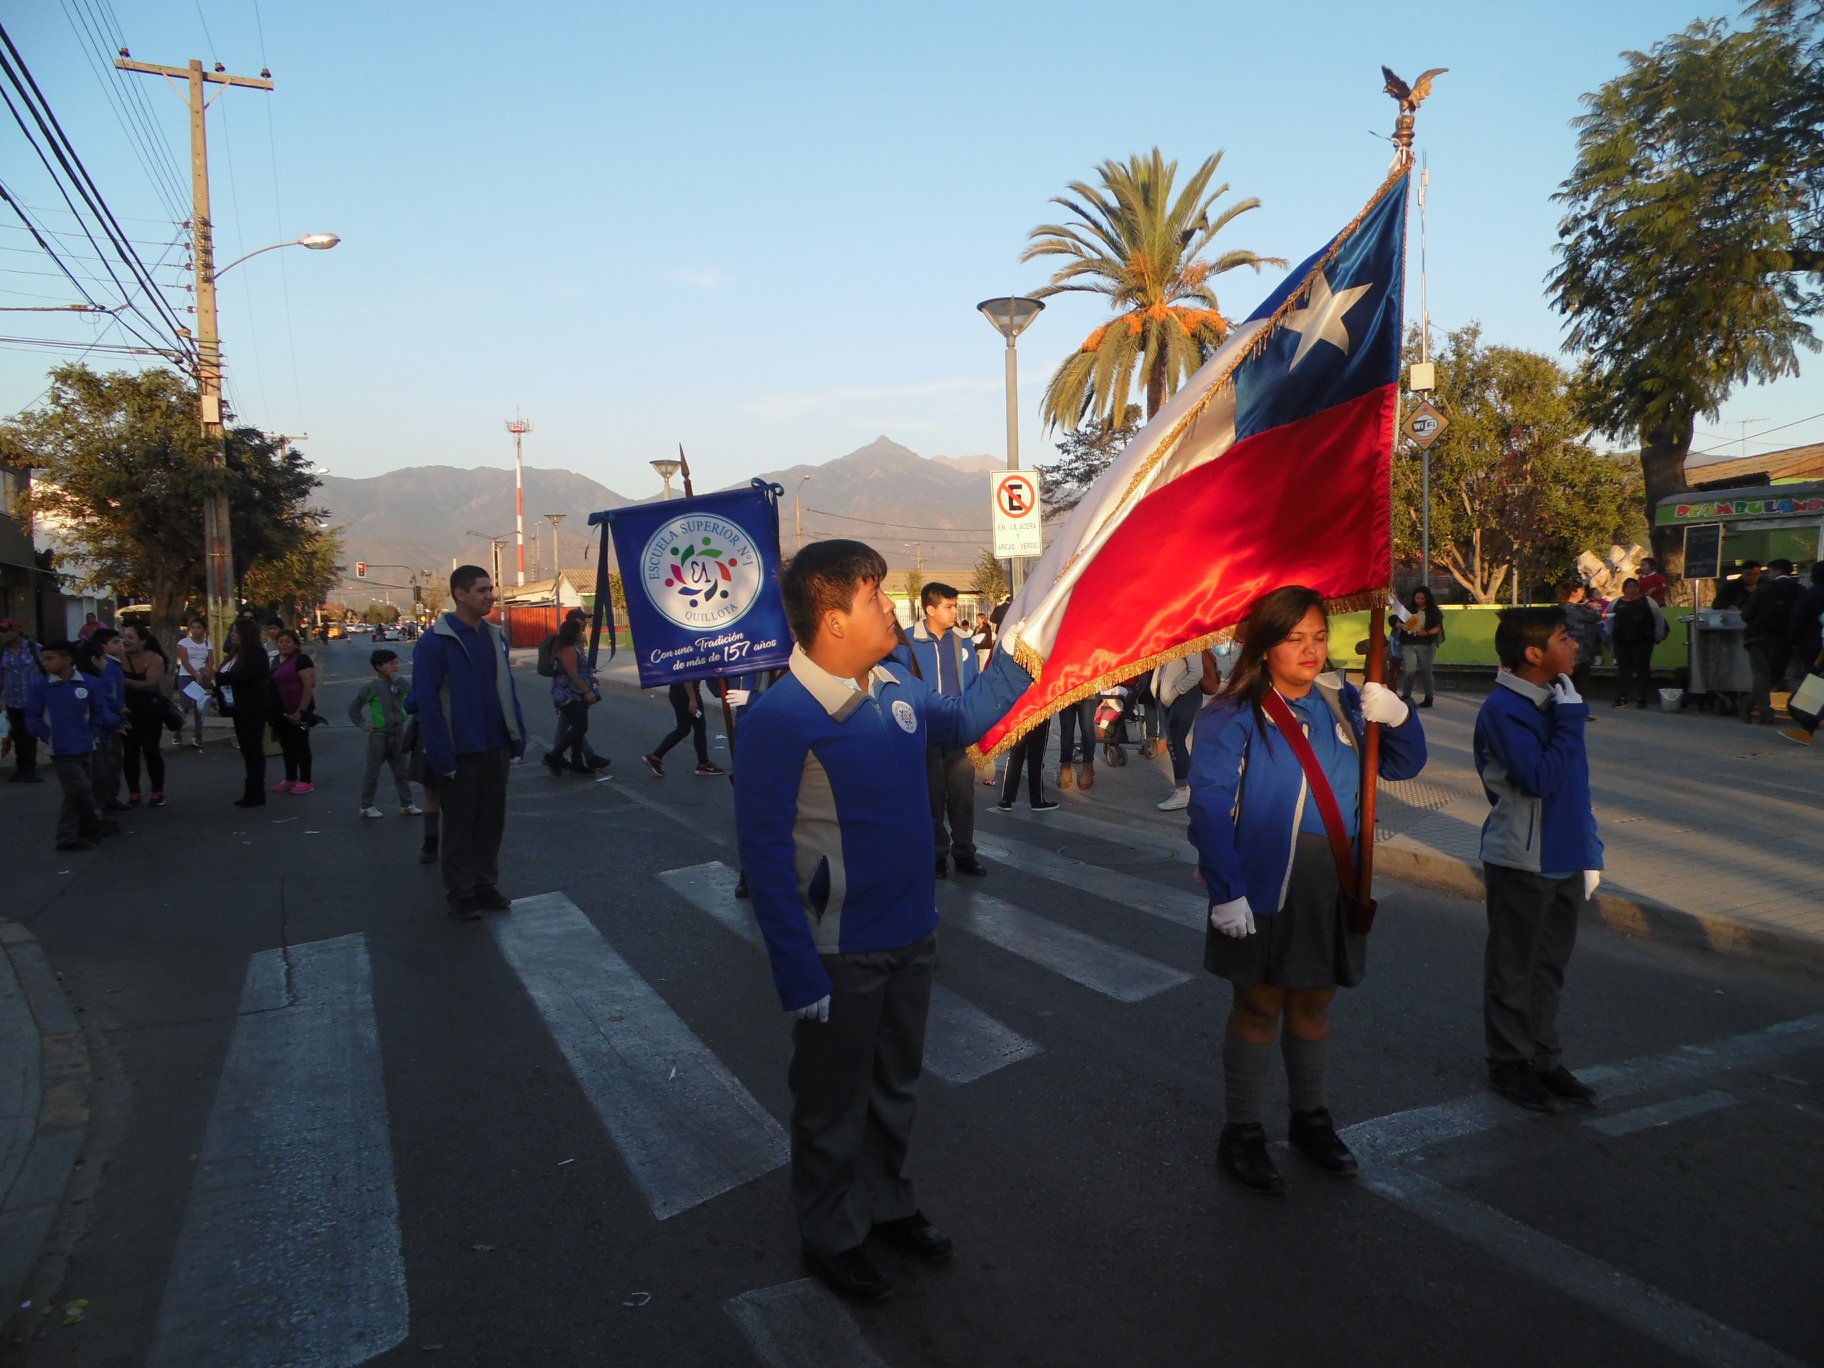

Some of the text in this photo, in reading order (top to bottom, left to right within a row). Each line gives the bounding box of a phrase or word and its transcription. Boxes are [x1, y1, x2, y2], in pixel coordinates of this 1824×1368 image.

[1008, 484, 1023, 511] E
[1675, 497, 1824, 517] DEAMBULAND
[997, 522, 1037, 531] EN LA ACERA
[648, 530, 679, 580] ESCUELA
[680, 520, 740, 547] SUPERIOR
[684, 603, 739, 622] QUILLOTA
[650, 632, 745, 664] Con una Tradición
[672, 639, 777, 672] de más de 157 años
